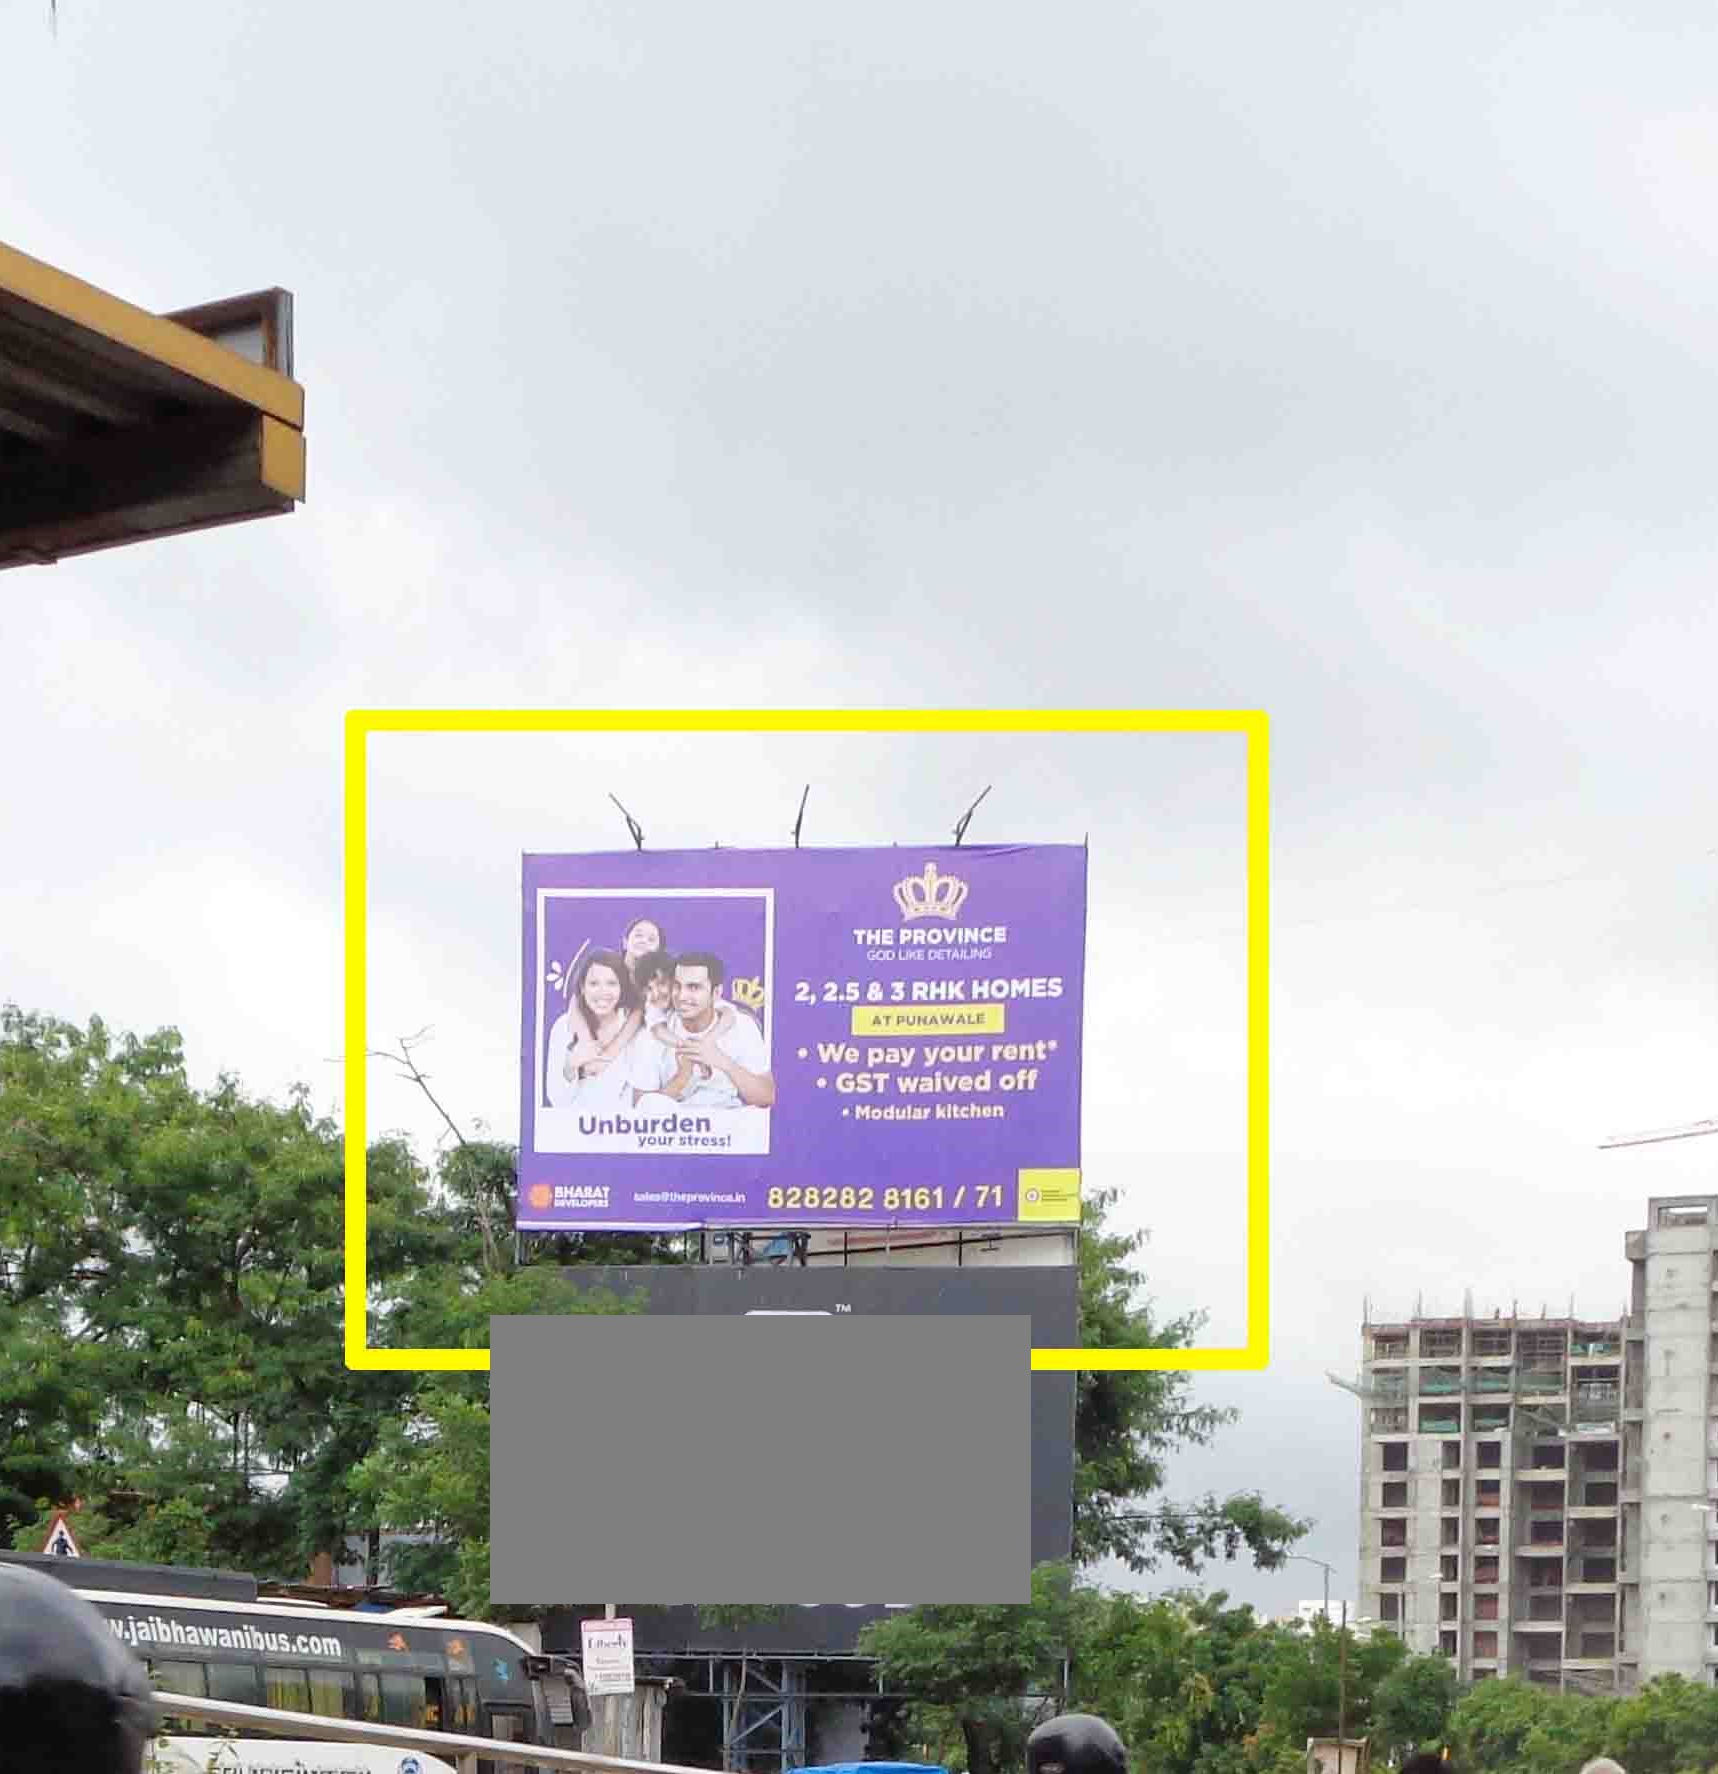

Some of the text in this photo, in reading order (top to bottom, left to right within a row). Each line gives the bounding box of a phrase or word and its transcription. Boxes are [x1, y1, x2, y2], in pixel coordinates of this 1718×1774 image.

[853, 927, 1006, 945] THE PROVINCE
[867, 947, 992, 961] GOD LIKE DETAILING
[794, 982, 816, 1005] 2,
[822, 981, 860, 1001] 2.5
[866, 981, 883, 1001] &
[890, 981, 906, 1001] 3
[971, 977, 1064, 1000] HOMES
[871, 1014, 892, 1027] AT
[817, 1043, 860, 1065] We
[867, 1046, 916, 1068] pay
[924, 1043, 985, 1067] your
[835, 1068, 1039, 1094] GST waived off
[854, 1102, 1005, 1121] Modular kitchen
[577, 1113, 712, 1136] Unburden
[637, 1134, 732, 1148] your stress!
[554, 1185, 611, 1199] BHARAT
[767, 1184, 1004, 1210] 828282 8161 / 71
